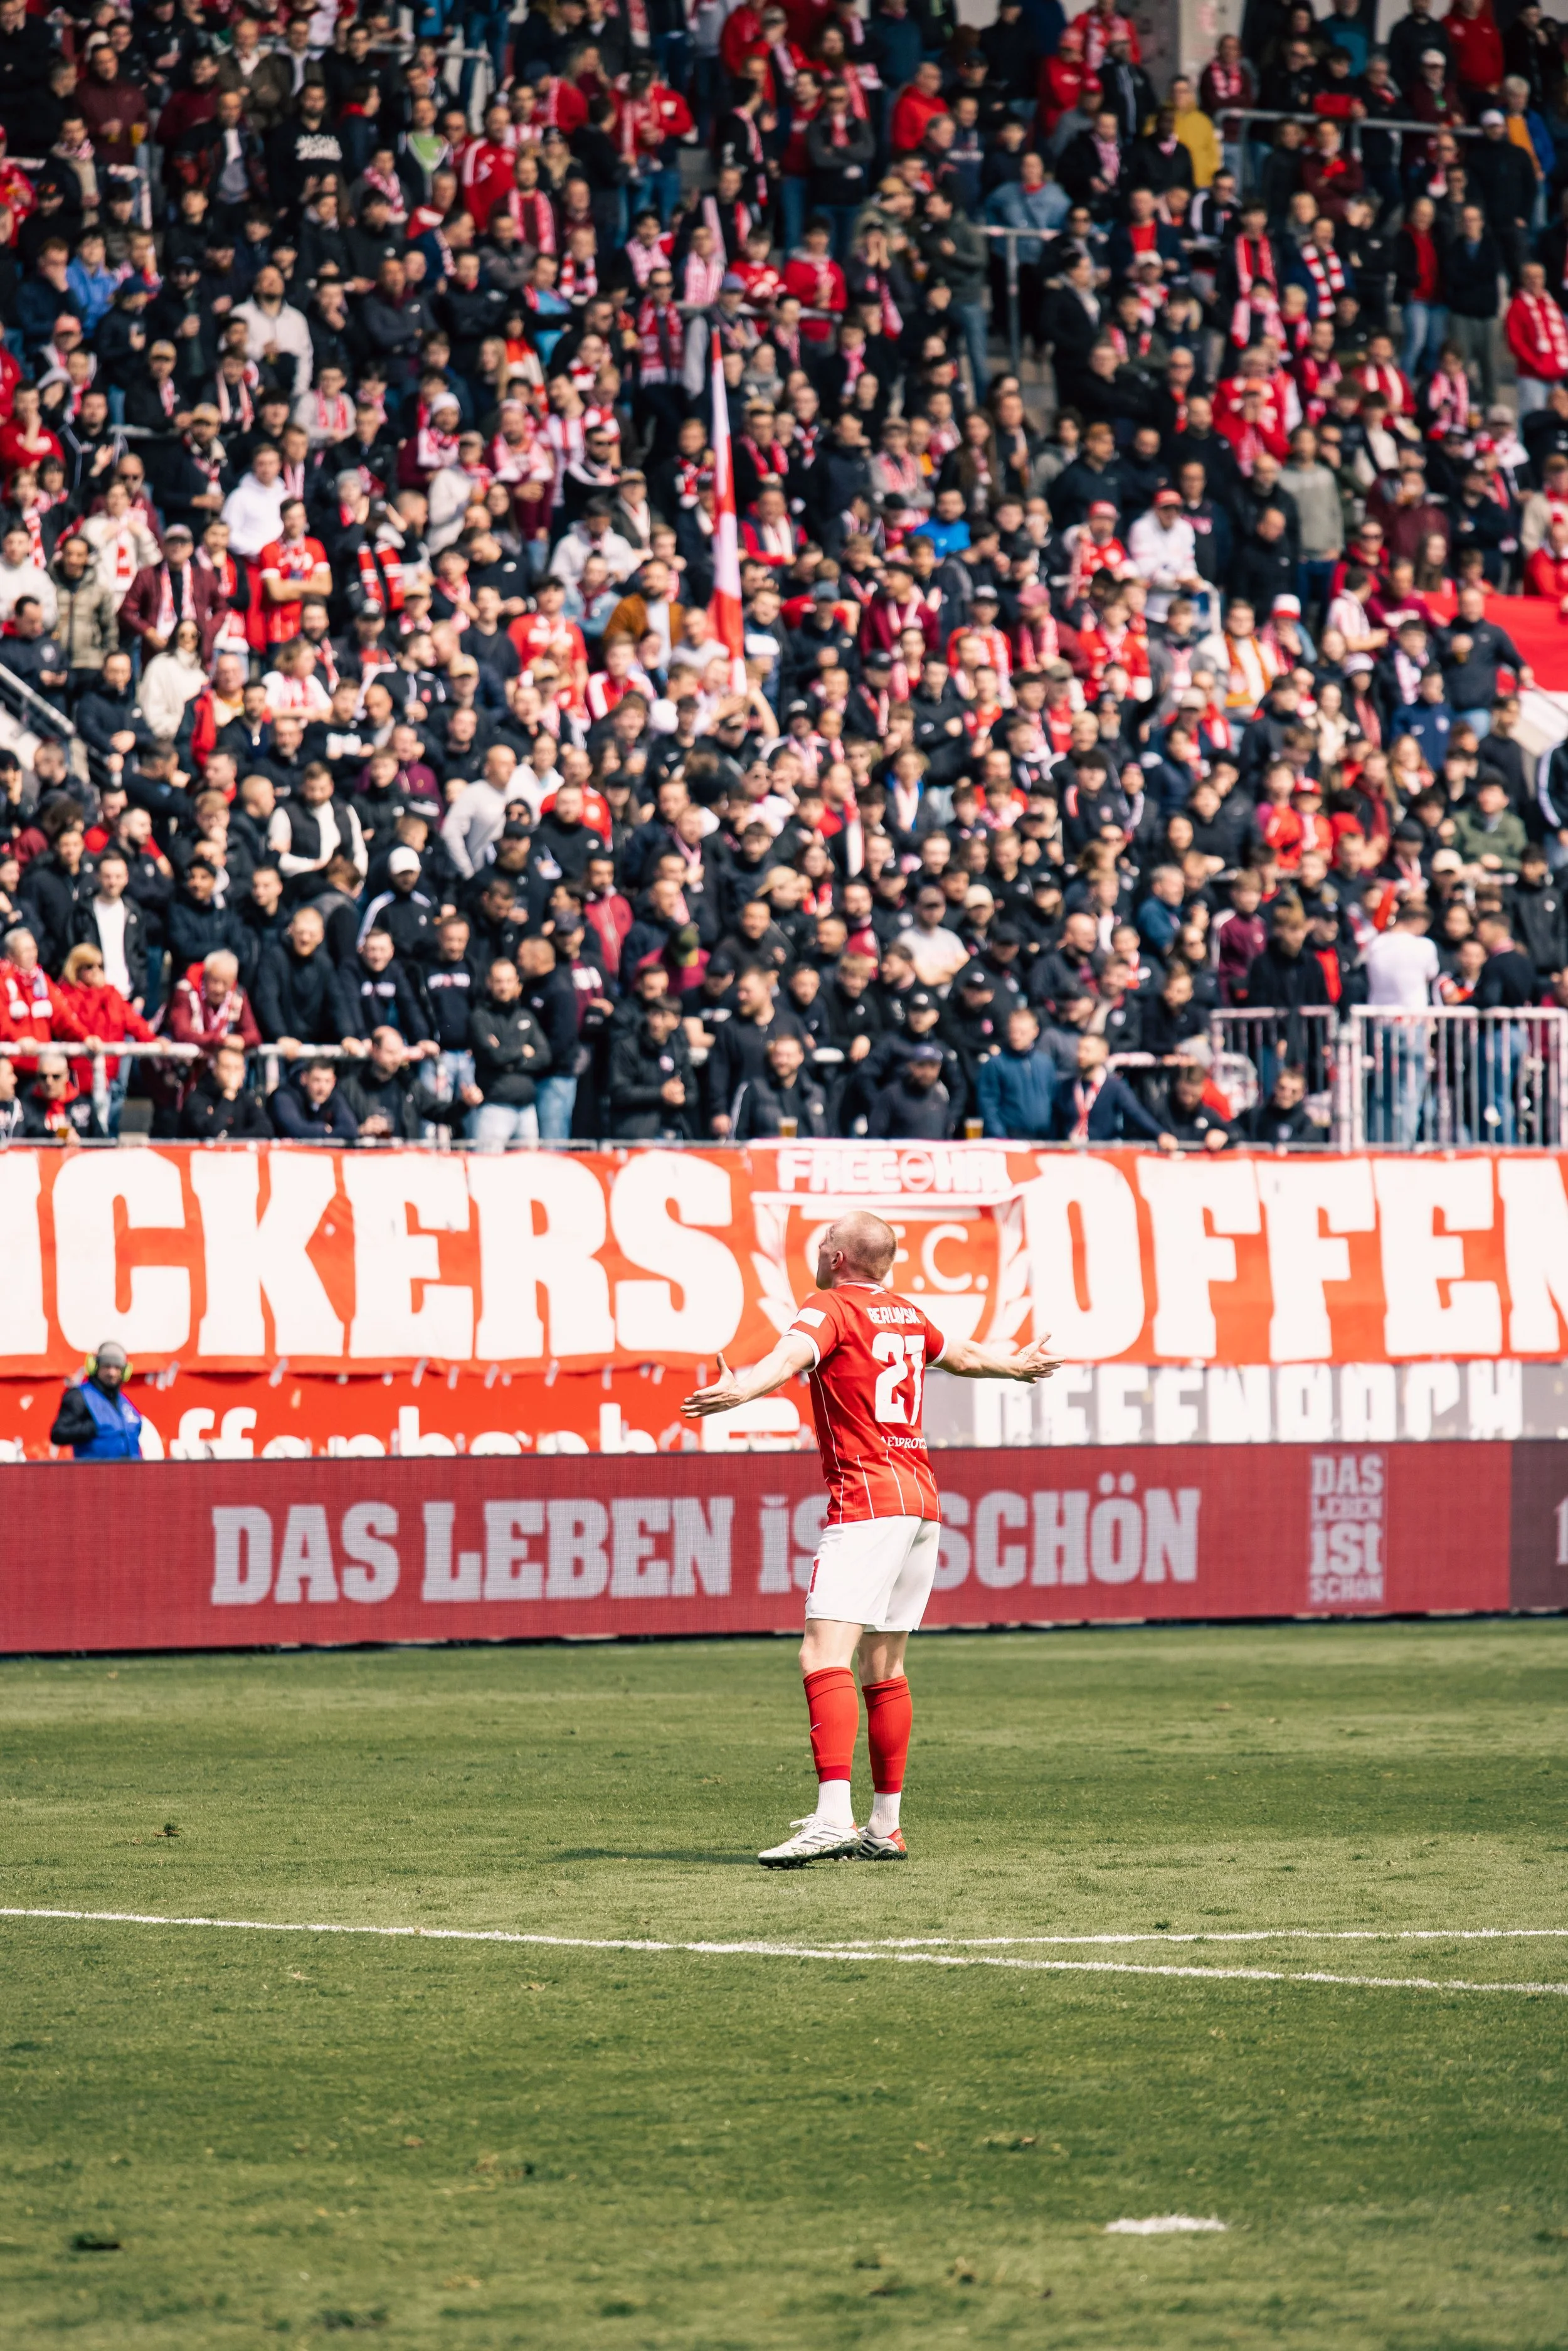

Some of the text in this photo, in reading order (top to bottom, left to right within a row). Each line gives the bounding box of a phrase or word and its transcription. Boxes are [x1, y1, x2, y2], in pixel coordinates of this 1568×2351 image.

[871, 1332, 925, 1426] 27
[1311, 1455, 1383, 1495] DAS
[211, 1502, 400, 1606] DAS
[421, 1496, 734, 1603] LEBEN
